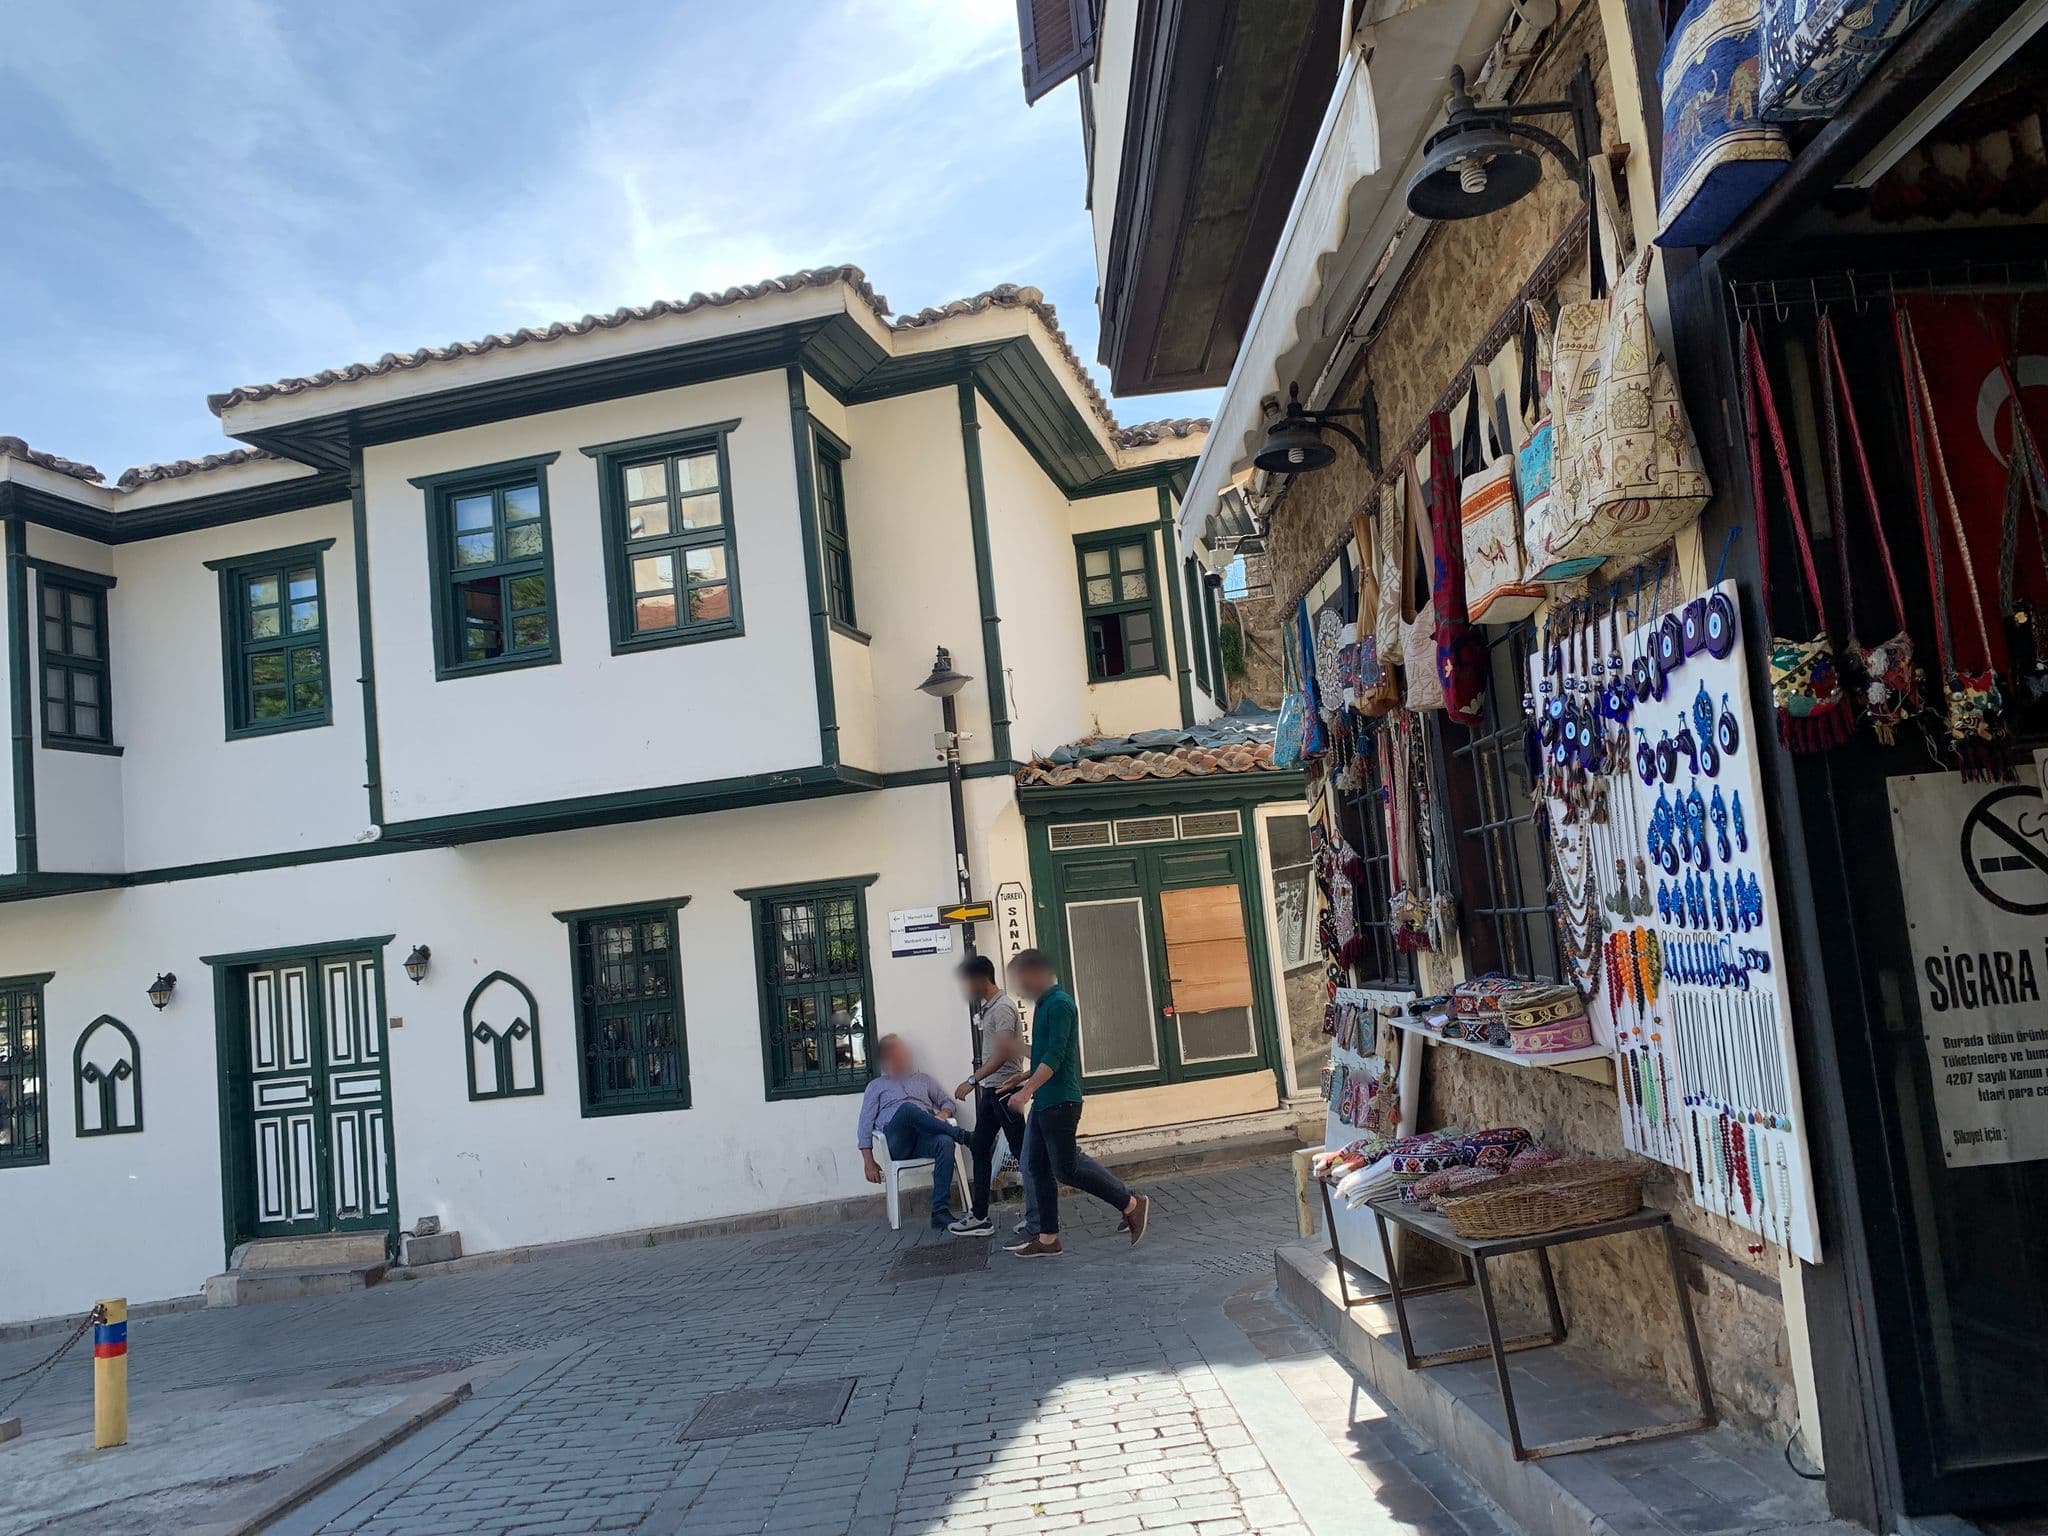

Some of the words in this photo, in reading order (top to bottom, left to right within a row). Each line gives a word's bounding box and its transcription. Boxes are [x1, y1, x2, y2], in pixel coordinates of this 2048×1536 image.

[1925, 945, 2040, 1012] SİGARA
[1943, 1035, 1984, 1049] Burada
[1987, 1032, 2014, 1045] tütün
[1942, 1053, 2007, 1068] Tüketenlere
[2010, 1051, 2023, 1062] ve
[2009, 1068, 2042, 1080] Kanun
[2008, 1087, 2034, 1101] para
